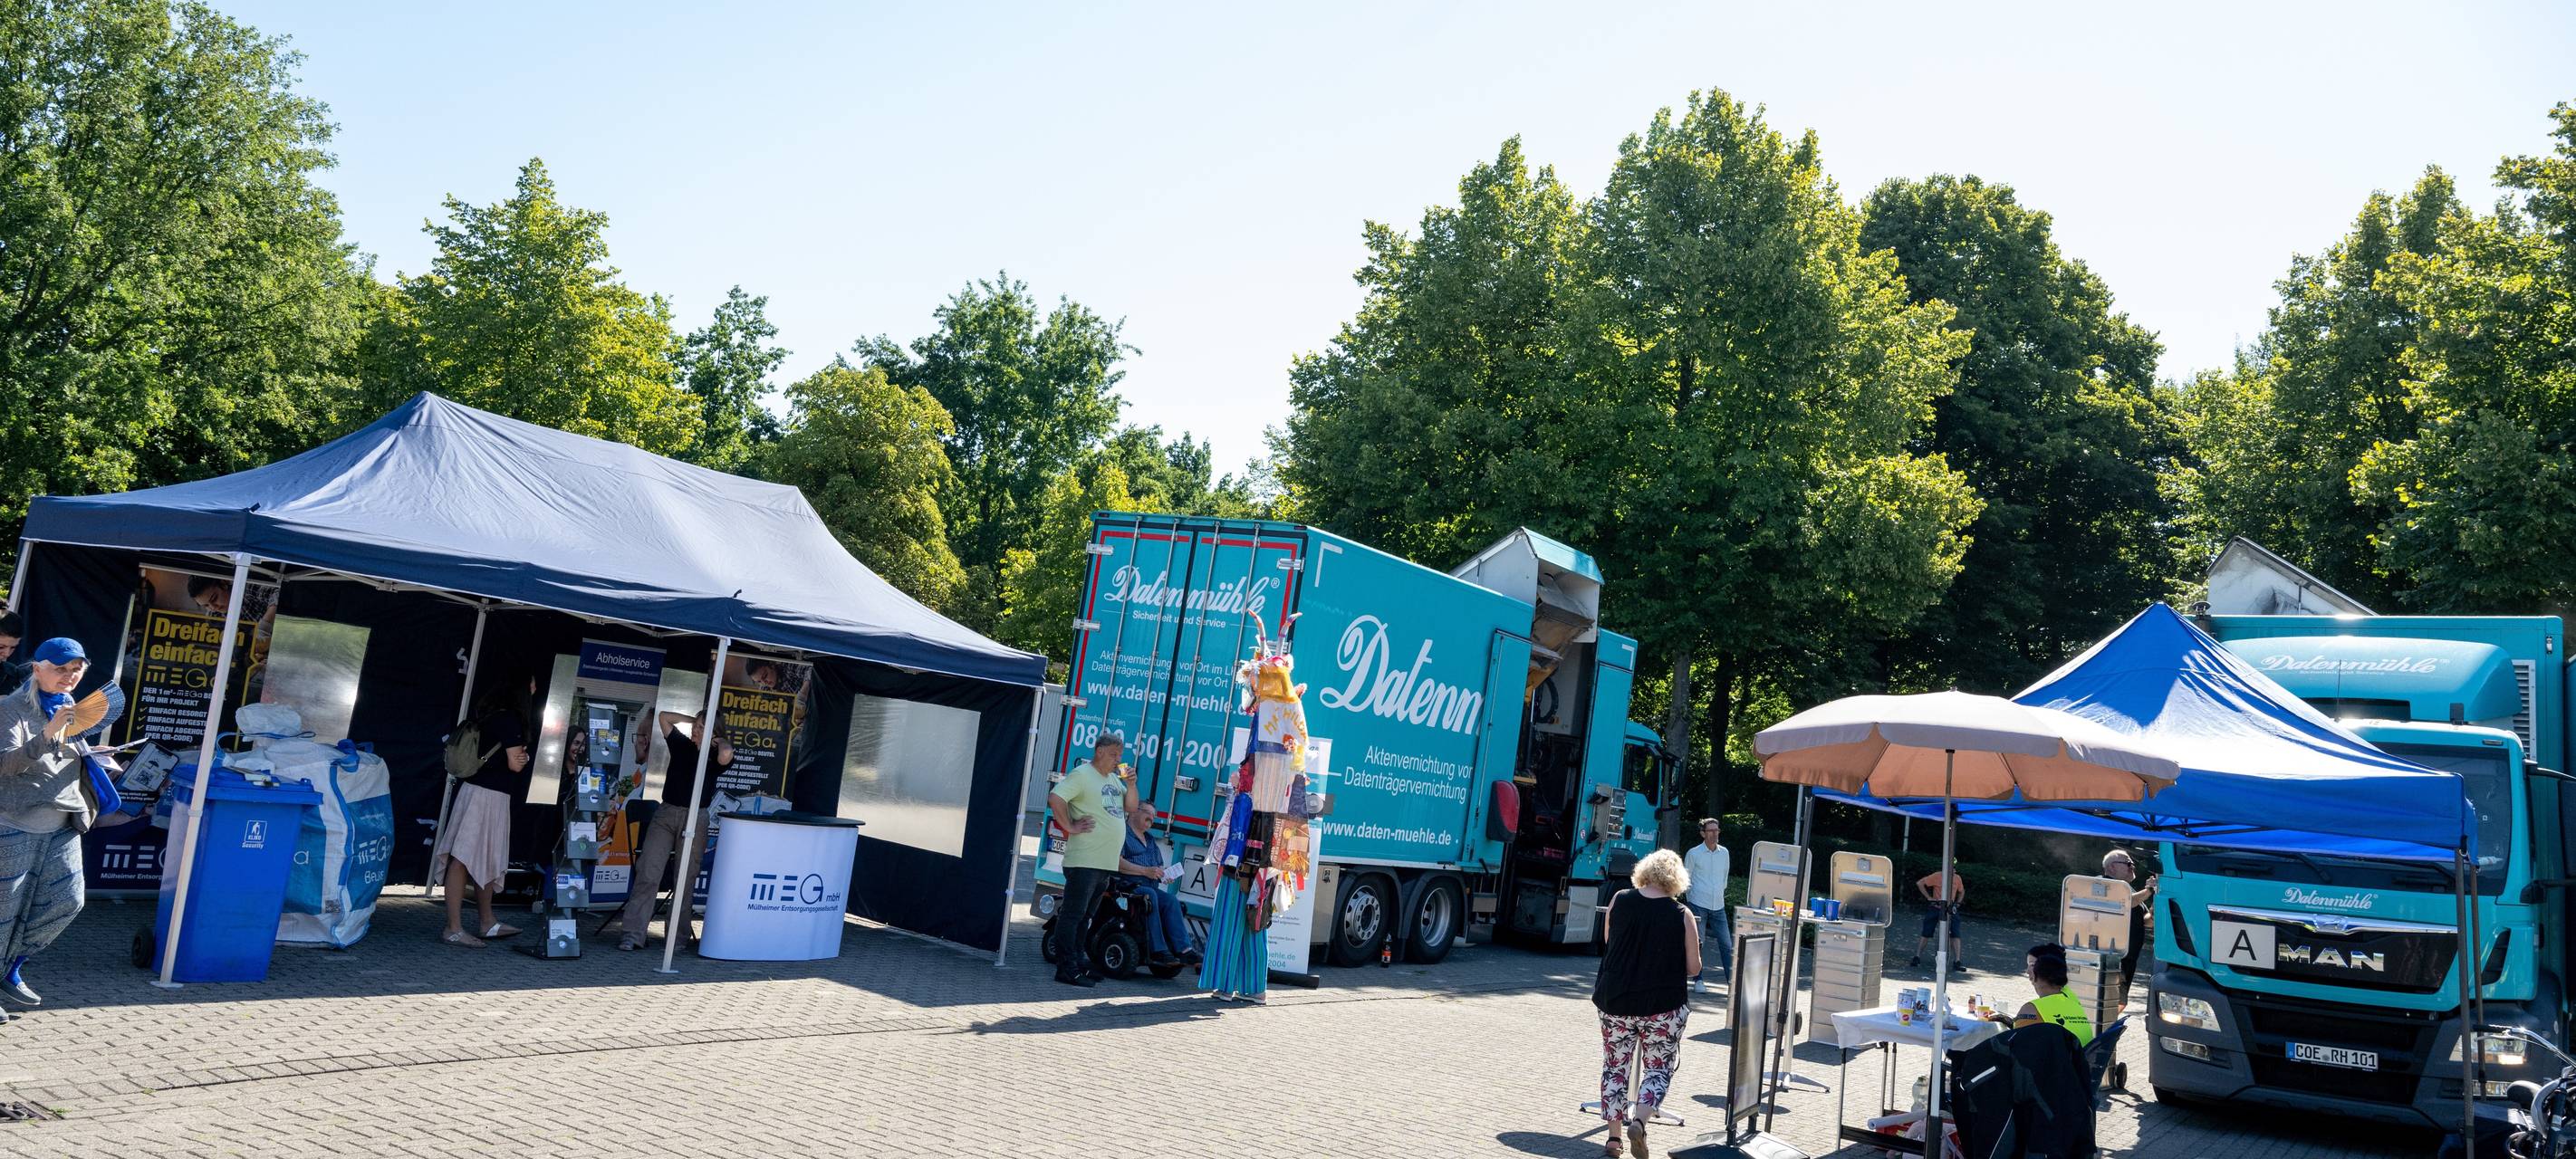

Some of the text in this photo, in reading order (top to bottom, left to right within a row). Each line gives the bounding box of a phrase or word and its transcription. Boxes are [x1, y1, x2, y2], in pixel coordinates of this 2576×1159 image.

[1132, 610, 1172, 623] Sichereit
[154, 617, 245, 647] Dreifah
[149, 641, 235, 667] einfac.
[596, 651, 650, 669] Abholservice
[1179, 662, 1193, 671] vor
[1196, 661, 1209, 674] Ort
[1212, 664, 1223, 675] im
[1197, 676, 1212, 686] vor
[1214, 676, 1228, 688] Ort
[143, 686, 157, 694] DER
[157, 696, 168, 704] IHR
[169, 697, 199, 706] PROJEKT
[722, 692, 788, 714] Dreifach
[1087, 681, 1248, 716] www.daten-muehle.d
[149, 707, 207, 717] EINFACH BESORGT
[147, 716, 176, 725] EINFACH
[1107, 718, 1126, 726] nrufen
[146, 725, 173, 733] EINFACH
[161, 734, 193, 742] QR-CODE)
[1364, 745, 1474, 781] Aktenvernichtung vor
[1344, 766, 1467, 804] Datenträgervernichtung
[1322, 820, 1452, 846] www.daten-muehle.de
[1053, 840, 1065, 852] COE
[101, 872, 136, 880] Mülheimer
[1190, 867, 1206, 892] A
[825, 892, 841, 902] mbH
[747, 903, 839, 914] Mülheimer Entsorgungsgesellschaft
[2228, 929, 2256, 961] A
[2278, 943, 2384, 972] MAN
[2296, 1045, 2321, 1060] COE
[2331, 1049, 2348, 1063] RH
[2351, 1052, 2376, 1068] 101
